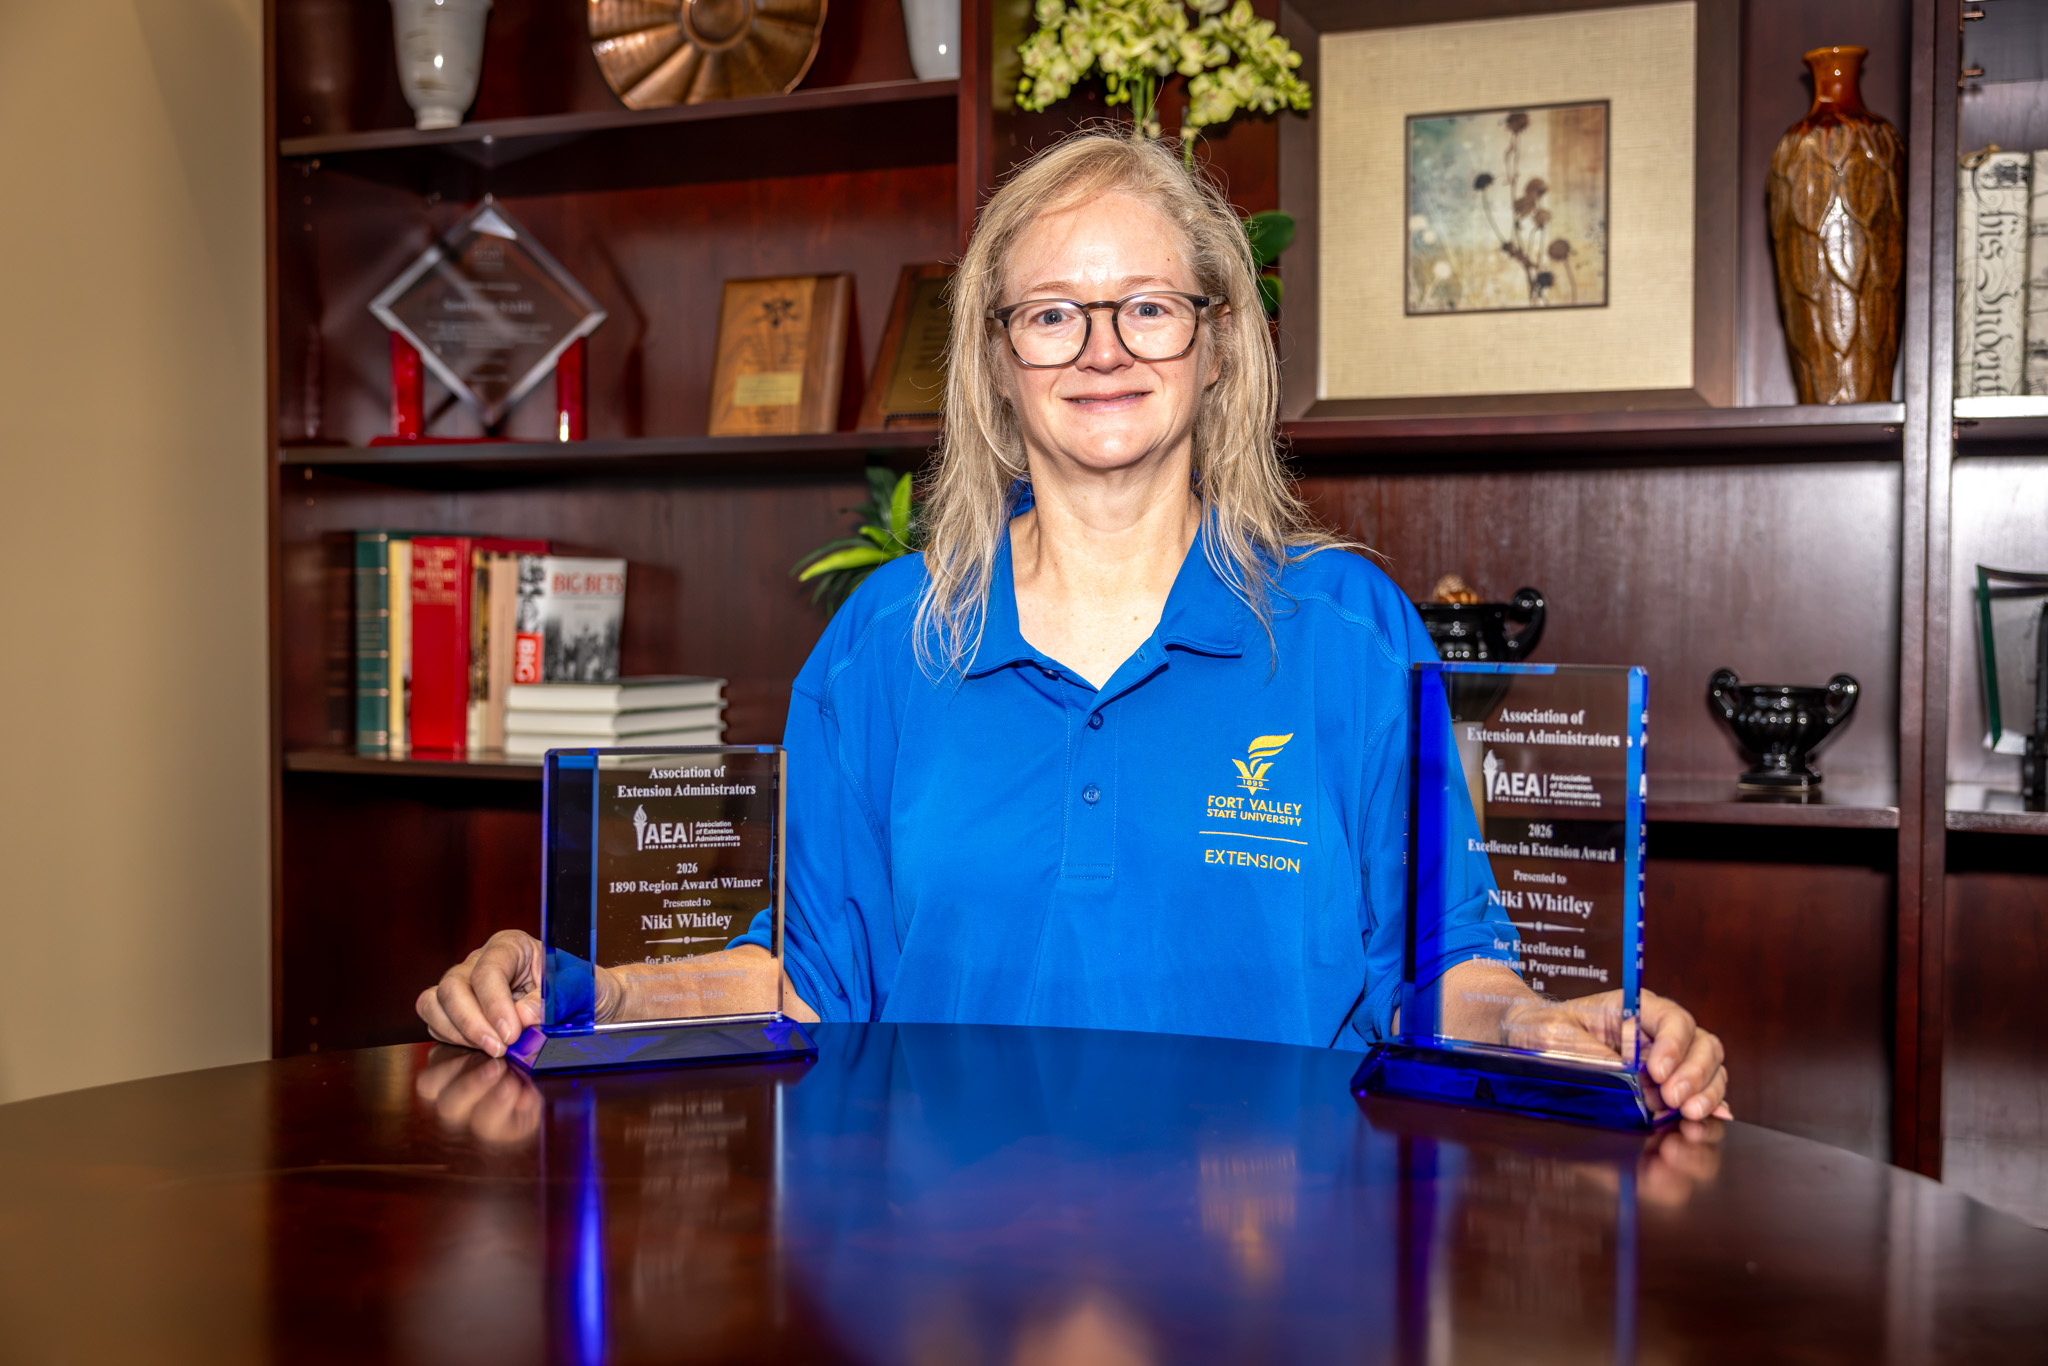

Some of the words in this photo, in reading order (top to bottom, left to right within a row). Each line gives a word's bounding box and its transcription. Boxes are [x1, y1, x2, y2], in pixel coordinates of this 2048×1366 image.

[553, 573, 582, 595] BIG
[585, 573, 624, 595] BETS
[1499, 708, 1568, 725] Association
[1570, 709, 1586, 725] of
[1466, 727, 1525, 743] Extension
[1526, 729, 1621, 748] Administrators
[648, 766, 711, 779] Association
[714, 765, 726, 778] of
[617, 784, 672, 798] Extension
[674, 783, 756, 796] Administrators
[1242, 779, 1264, 787] 1895
[1495, 772, 1542, 797] AEA
[1207, 795, 1244, 809] FORT
[1249, 798, 1302, 816] VALLEY
[1206, 808, 1237, 819] STATE
[1240, 811, 1302, 827] UNIVERSITY
[645, 823, 688, 844] AEA
[703, 827, 734, 835] Extension
[1528, 823, 1554, 838] 2026
[1468, 838, 1518, 855] Excellence
[1519, 842, 1529, 855] in
[1531, 843, 1580, 859] Extension
[1581, 846, 1616, 862] Award
[676, 862, 699, 874] 2026
[1205, 849, 1300, 874] EXTENSION
[609, 881, 637, 893] 1890
[638, 880, 679, 894] Region
[681, 878, 718, 891] Award
[720, 877, 763, 889] Winner
[1513, 869, 1556, 884] Presented
[1557, 873, 1567, 885] to
[663, 897, 701, 908] Presented
[703, 898, 711, 907] to
[1487, 889, 1523, 909] Niki
[1526, 892, 1594, 919] Whitley
[641, 914, 673, 930] Niki
[676, 912, 733, 930] Whitley
[1493, 938, 1510, 950] for
[1512, 939, 1572, 957] Excellence
[1573, 945, 1586, 959] in
[645, 955, 661, 966] for
[662, 953, 716, 965] Excellence
[1472, 954, 1526, 971] Extension
[1528, 959, 1609, 982] Programming
[1532, 977, 1545, 991] in
